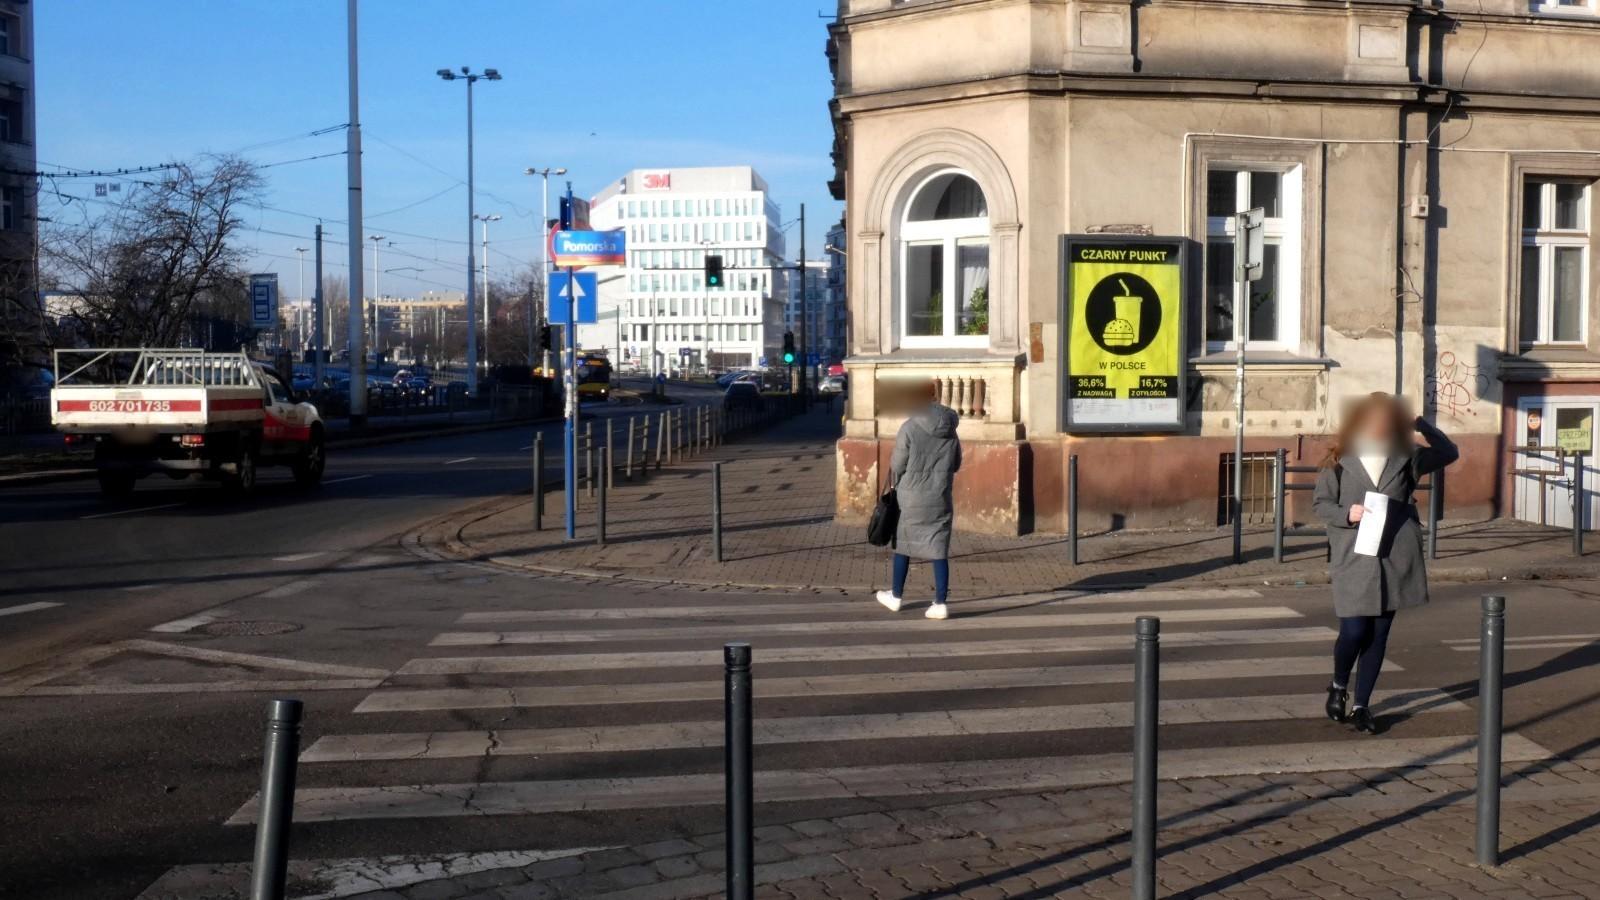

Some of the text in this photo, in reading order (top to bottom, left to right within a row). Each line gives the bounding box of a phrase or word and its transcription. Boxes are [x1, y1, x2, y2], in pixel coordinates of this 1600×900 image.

[643, 174, 670, 189] 3M
[563, 241, 616, 252] Pomorska
[1081, 249, 1167, 261] CZARNY PUNKT
[1099, 361, 1147, 370] W POLSCE
[1078, 379, 1104, 388] 36,6%
[1141, 379, 1168, 388] 16,7%
[89, 400, 170, 412] 602 701 735
